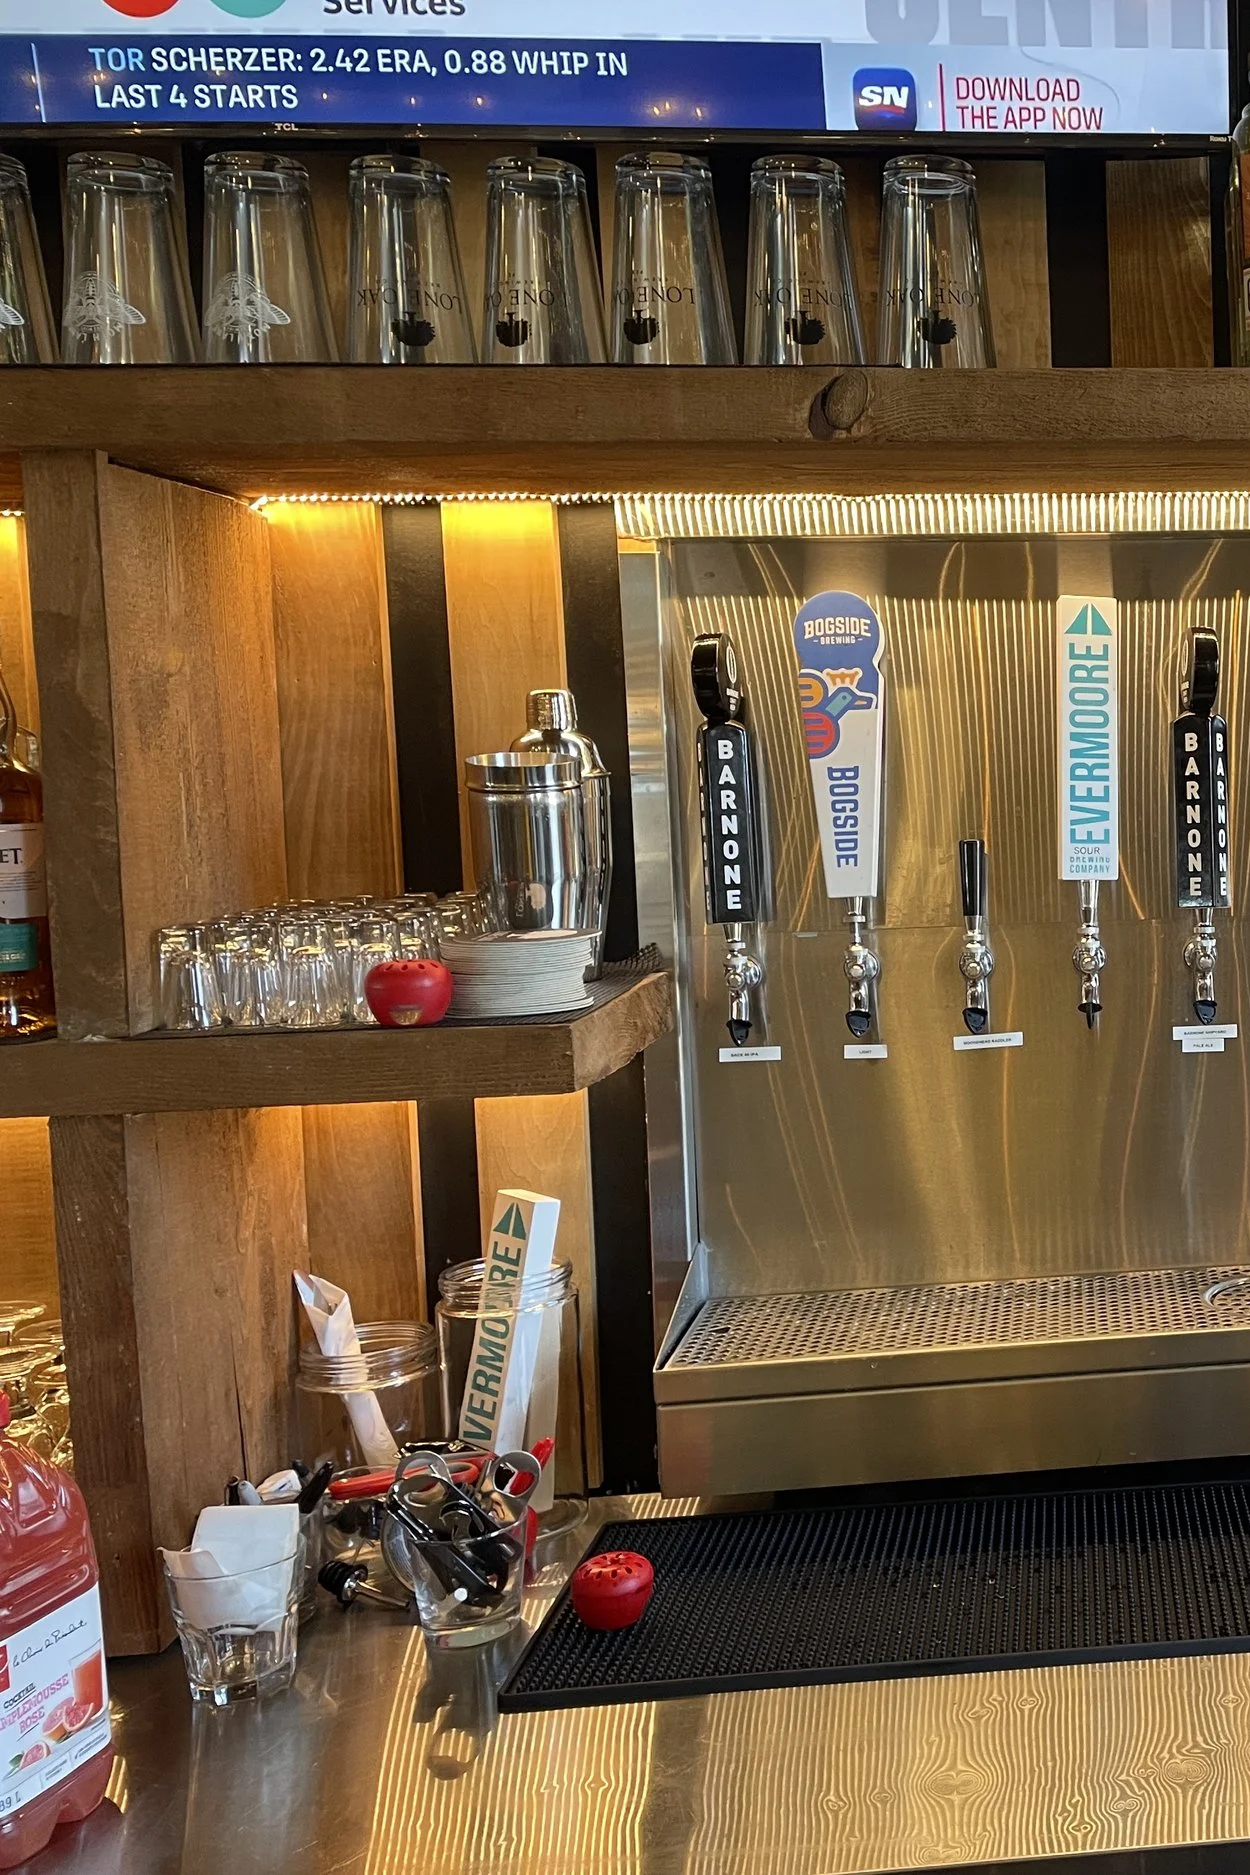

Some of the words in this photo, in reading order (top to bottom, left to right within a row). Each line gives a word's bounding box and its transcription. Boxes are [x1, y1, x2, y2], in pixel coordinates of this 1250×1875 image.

[88, 47, 145, 72] TOR
[151, 47, 303, 73] SCHERZER:
[309, 48, 371, 73] 2.42
[376, 49, 437, 77] ERA,
[444, 49, 507, 74] 0.88
[512, 50, 589, 76] WHIP
[597, 52, 628, 76] IN
[94, 84, 162, 108] LAST
[169, 85, 188, 108] 4
[194, 84, 299, 109] STARTS
[858, 85, 909, 108] SN
[956, 77, 1079, 103] DOWNLOAD
[274, 122, 299, 131] TCL
[956, 106, 998, 130] THE
[1003, 107, 1046, 131] APP
[1053, 107, 1103, 131] NOW
[804, 616, 871, 639] BOGSIDE
[820, 636, 856, 645] BREWING
[1069, 642, 1110, 845] EVERMOORE
[717, 739, 742, 910] BARNONE
[827, 766, 860, 868] BOGSIDE
[1184, 732, 1203, 897] BARNONE
[1216, 732, 1228, 896] BARNONE
[1074, 847, 1100, 855] SOUR
[1069, 865, 1110, 873] COMPANY
[463, 1241, 522, 1442] VERMORE
[0, 1673, 70, 1731] MPLEMOUSSE
[3, 1682, 36, 1710] COCKTAIL
[19, 1706, 45, 1734] ROSE
